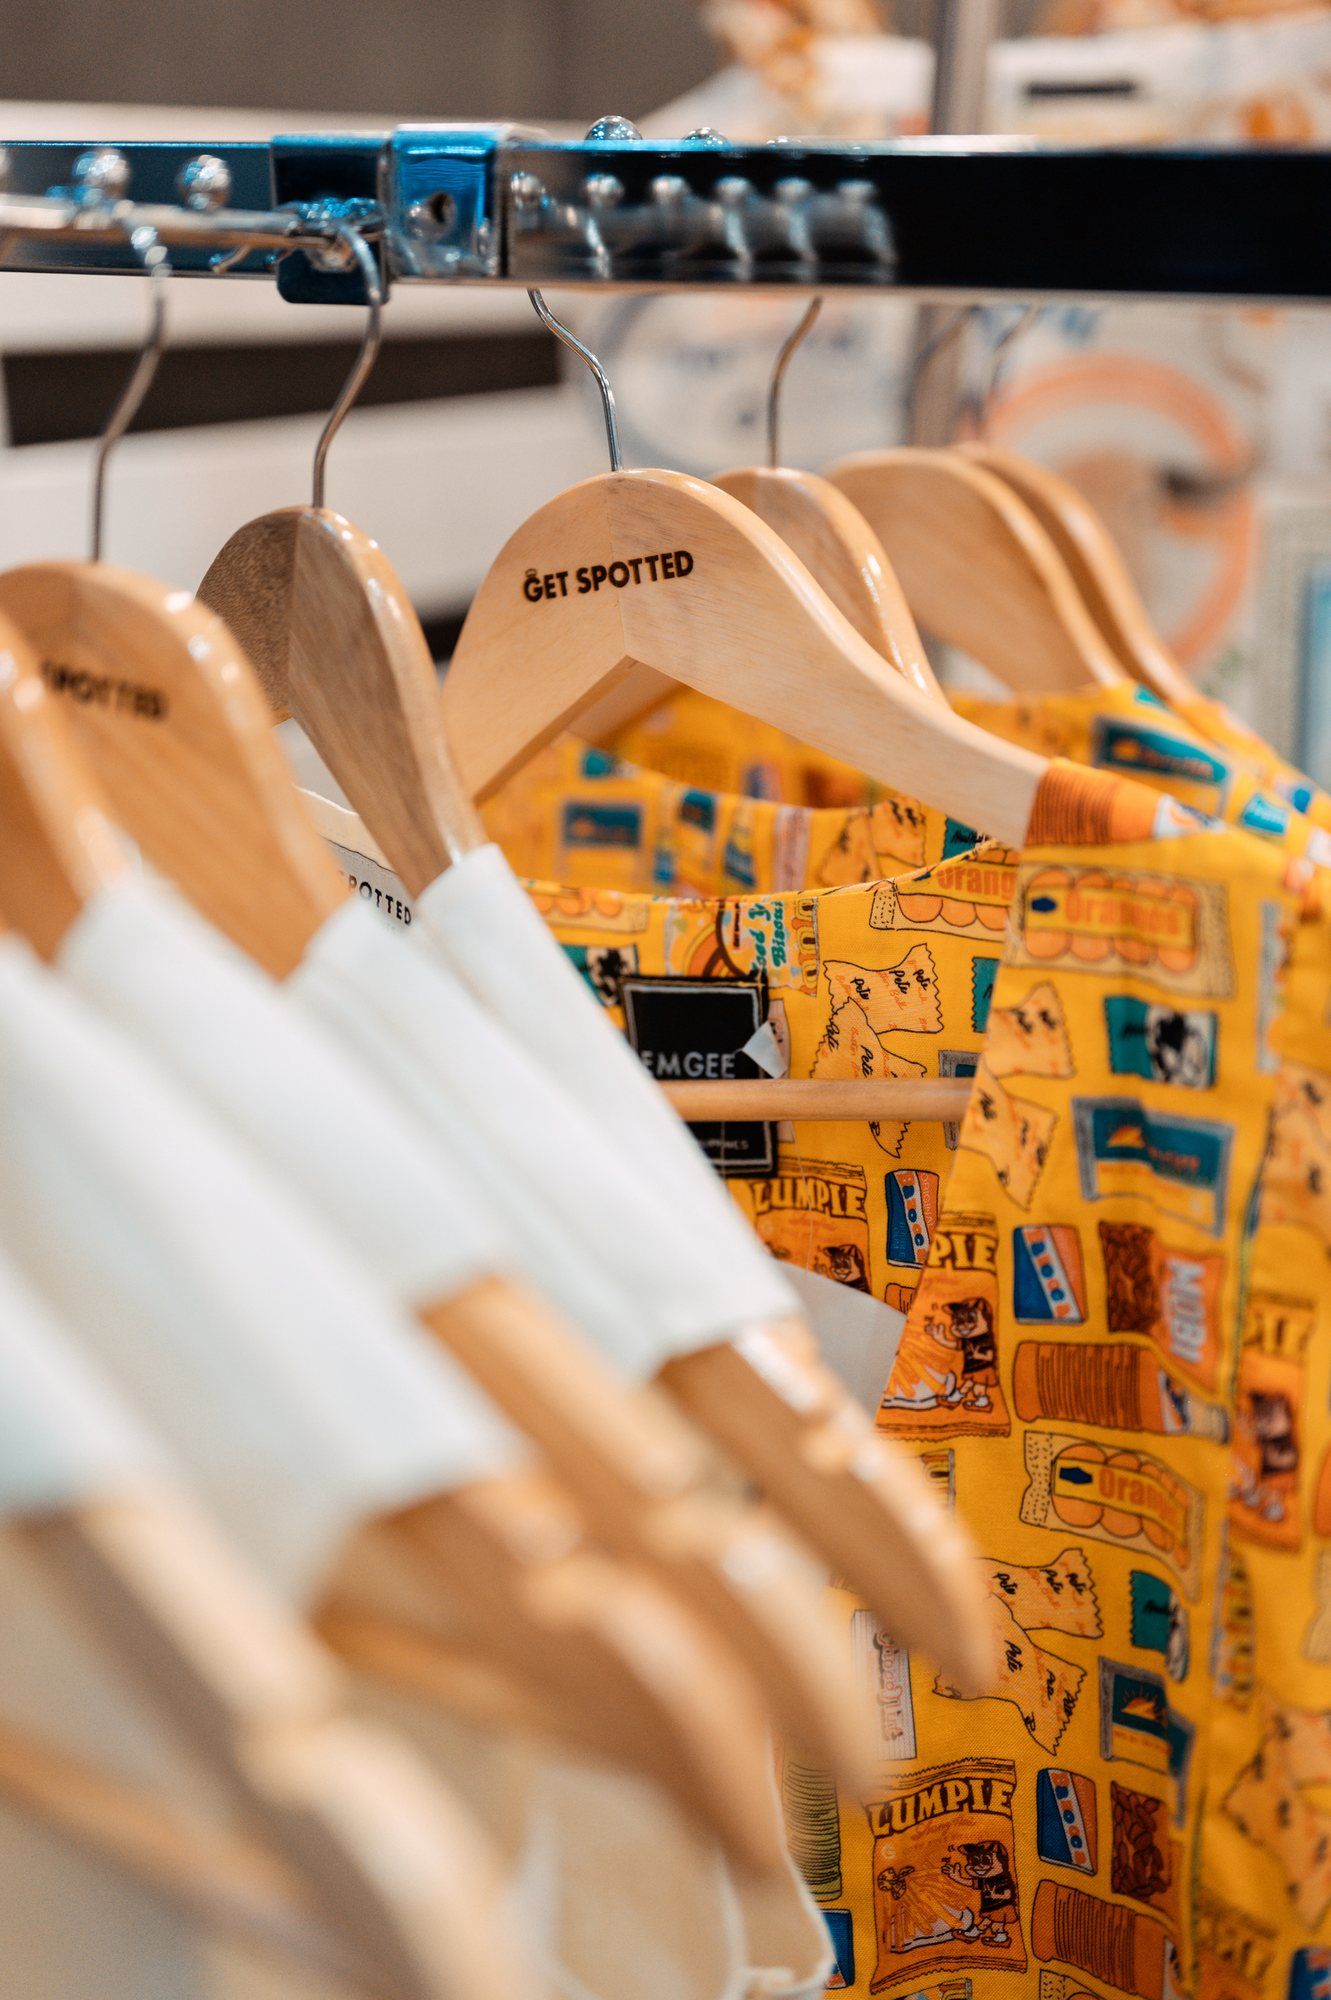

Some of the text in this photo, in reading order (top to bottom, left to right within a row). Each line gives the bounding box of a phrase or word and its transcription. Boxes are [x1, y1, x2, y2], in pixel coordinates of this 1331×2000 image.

[523, 550, 694, 602] GET SPOTTED
[339, 870, 411, 926] POTTED
[752, 1177, 867, 1221] LUMPIE
[927, 1231, 998, 1273] PIE
[869, 1778, 1016, 1837] LUMPIE
